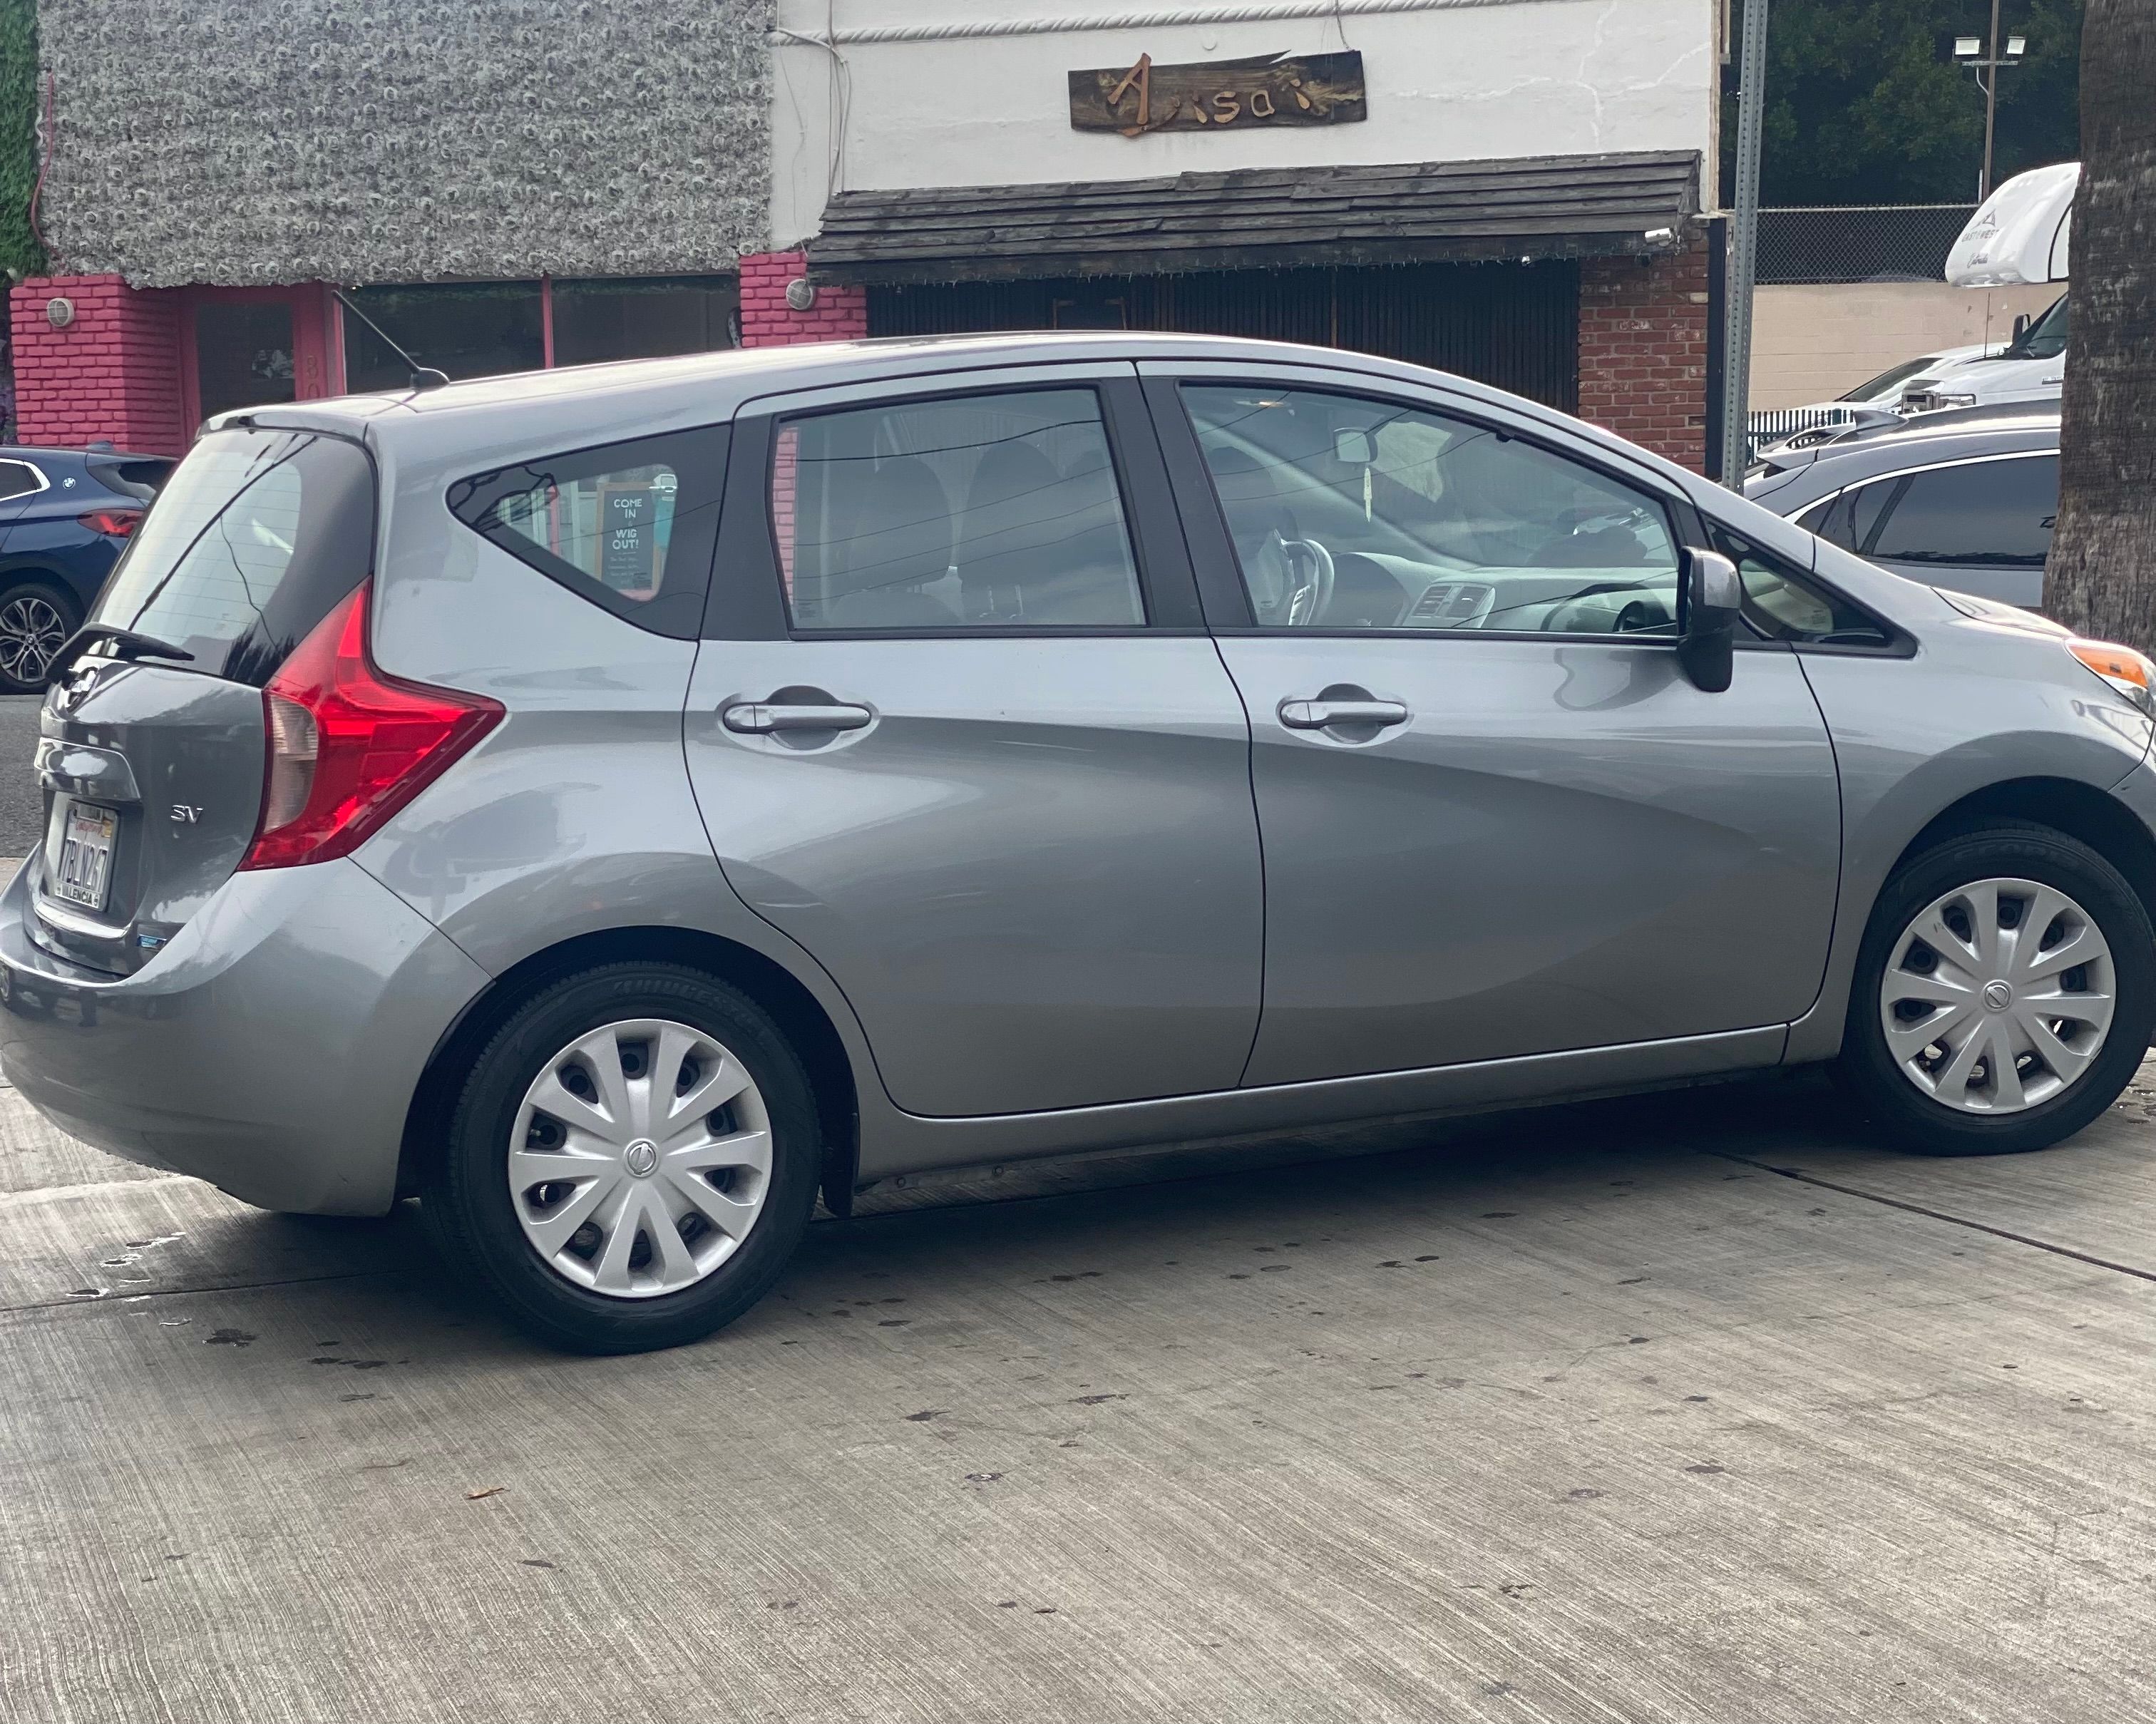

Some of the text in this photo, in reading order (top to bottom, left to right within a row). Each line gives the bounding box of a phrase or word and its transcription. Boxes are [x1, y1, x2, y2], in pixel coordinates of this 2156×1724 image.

[614, 498, 642, 508] COME
[625, 508, 636, 518] IN
[616, 529, 637, 538] WIG
[612, 539, 639, 550] OUT!
[170, 804, 203, 823] SV
